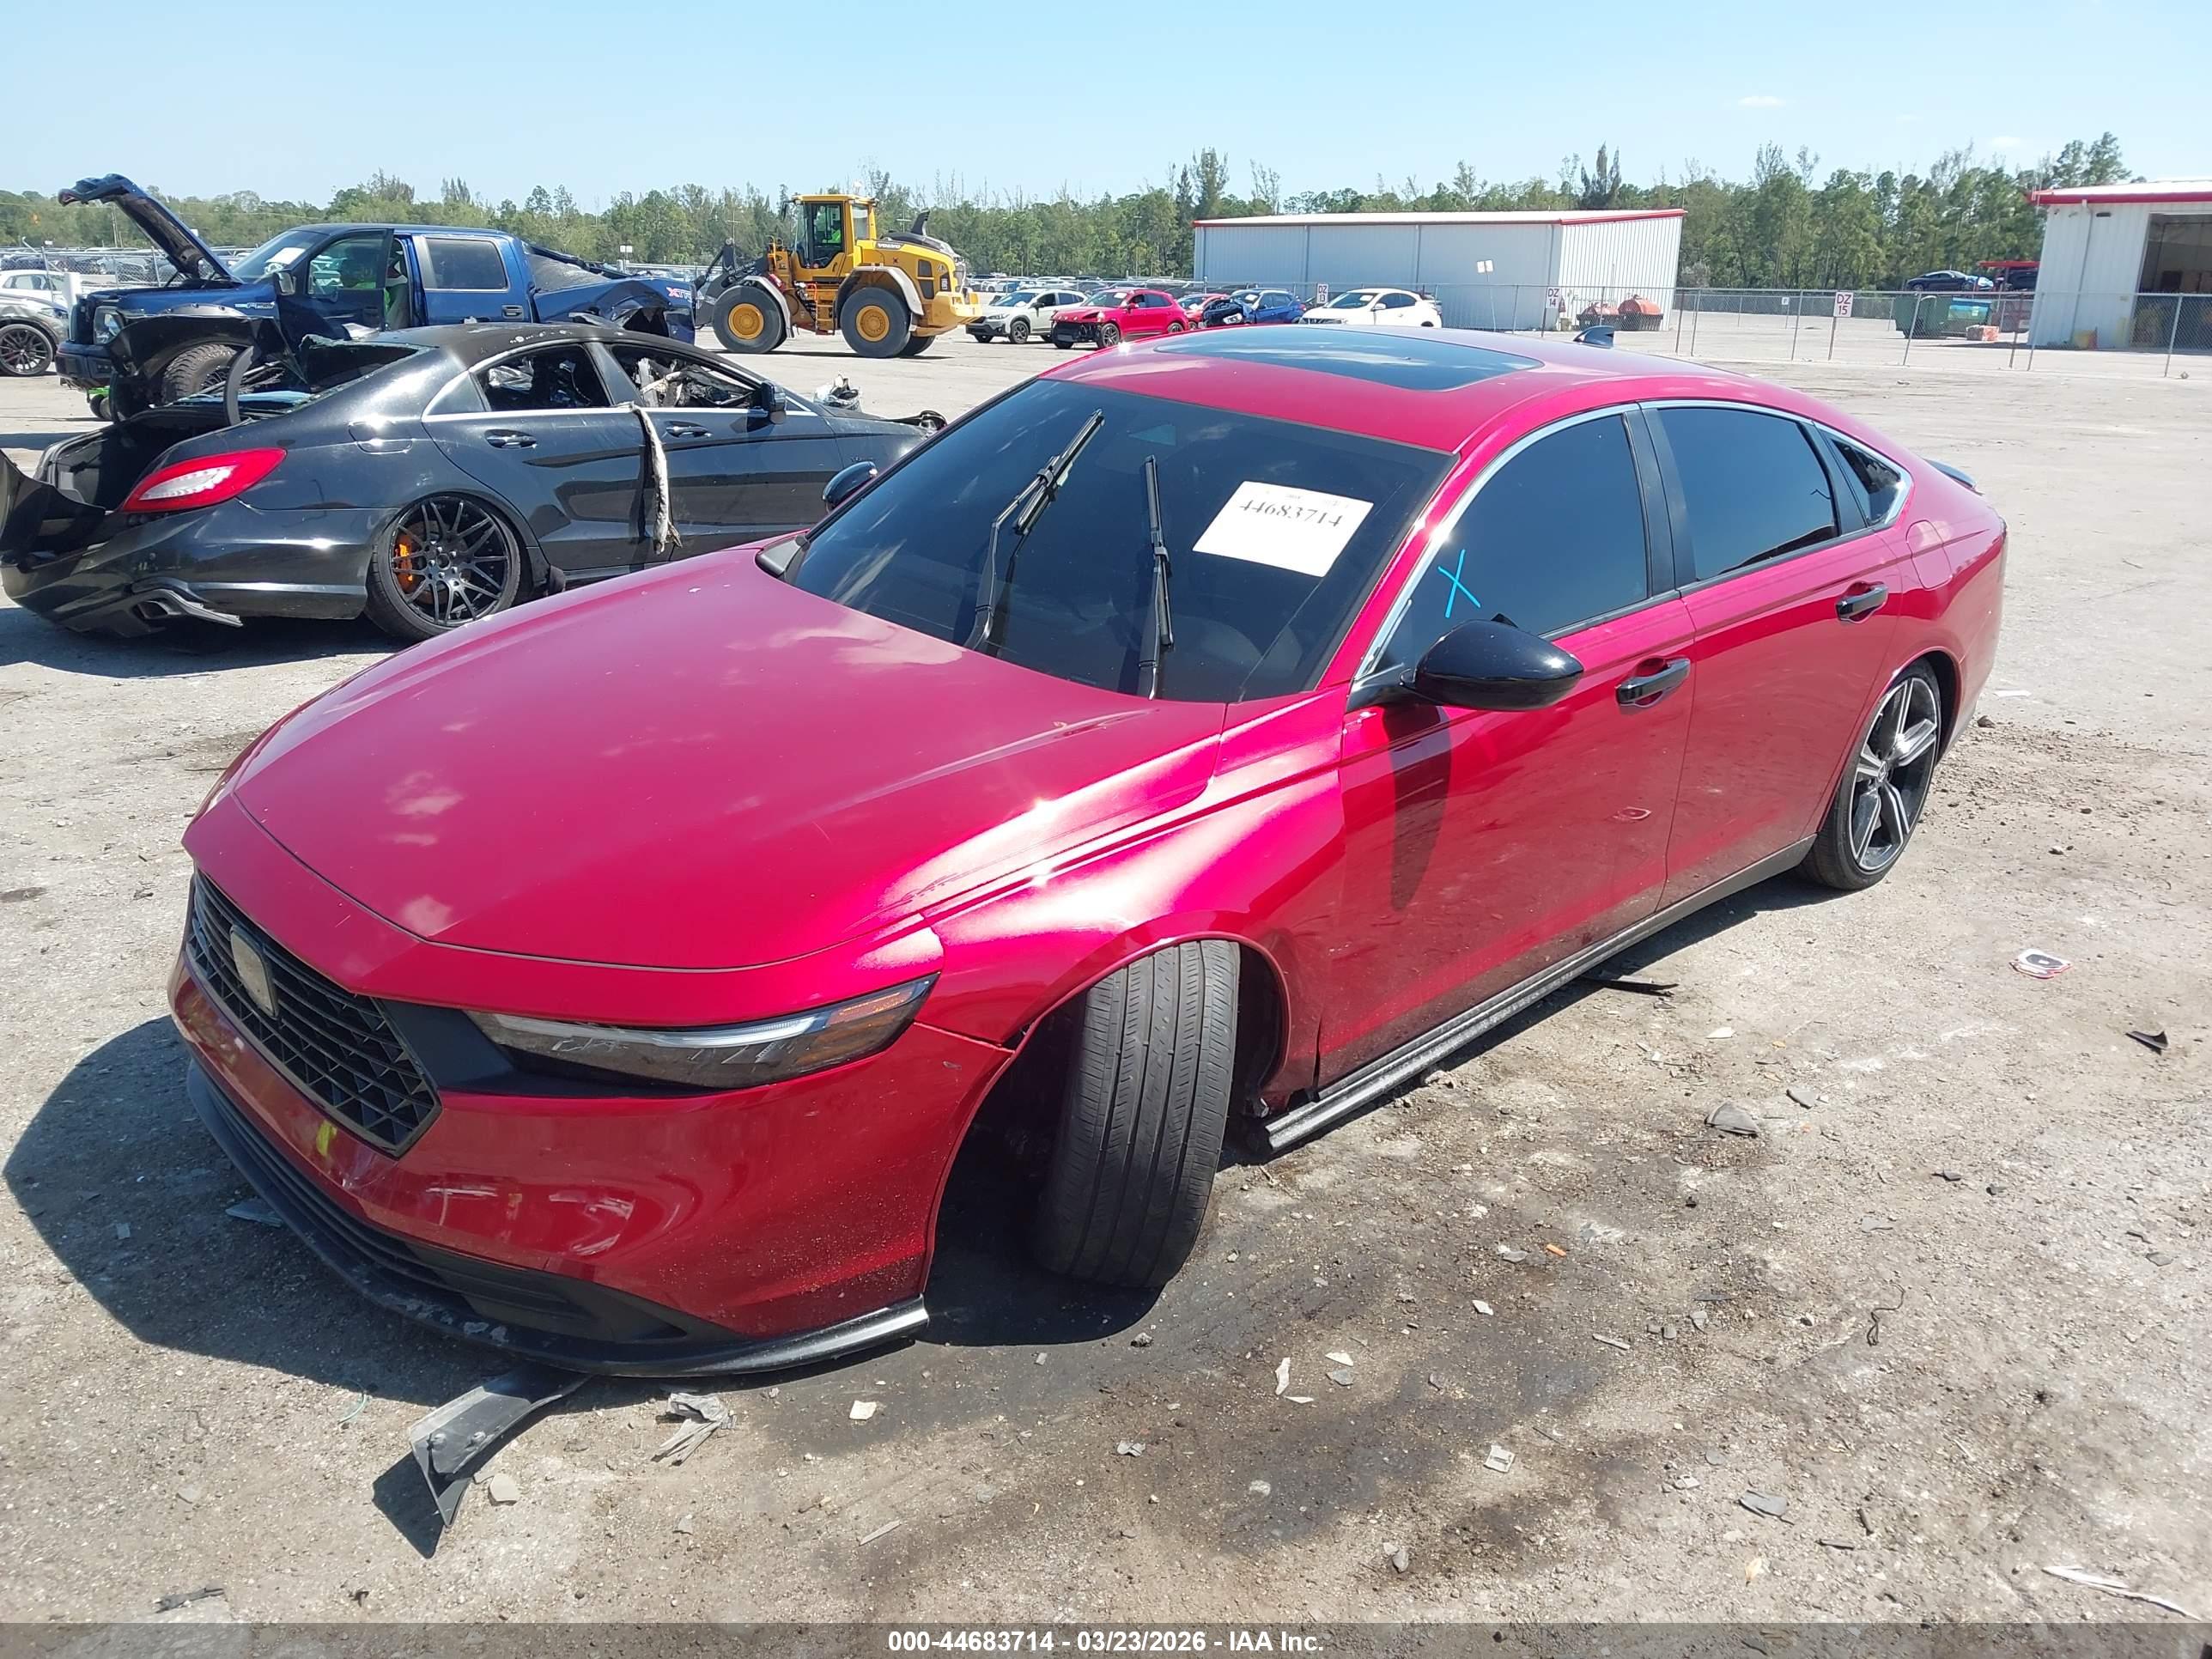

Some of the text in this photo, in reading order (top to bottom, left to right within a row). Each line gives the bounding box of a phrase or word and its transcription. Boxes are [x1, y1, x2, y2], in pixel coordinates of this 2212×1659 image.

[1547, 288, 1560, 297] DZ
[1549, 298, 1556, 307] 14
[1837, 294, 1851, 304] DZ
[1838, 305, 1847, 315] 15
[1240, 500, 1343, 526] 44683714
